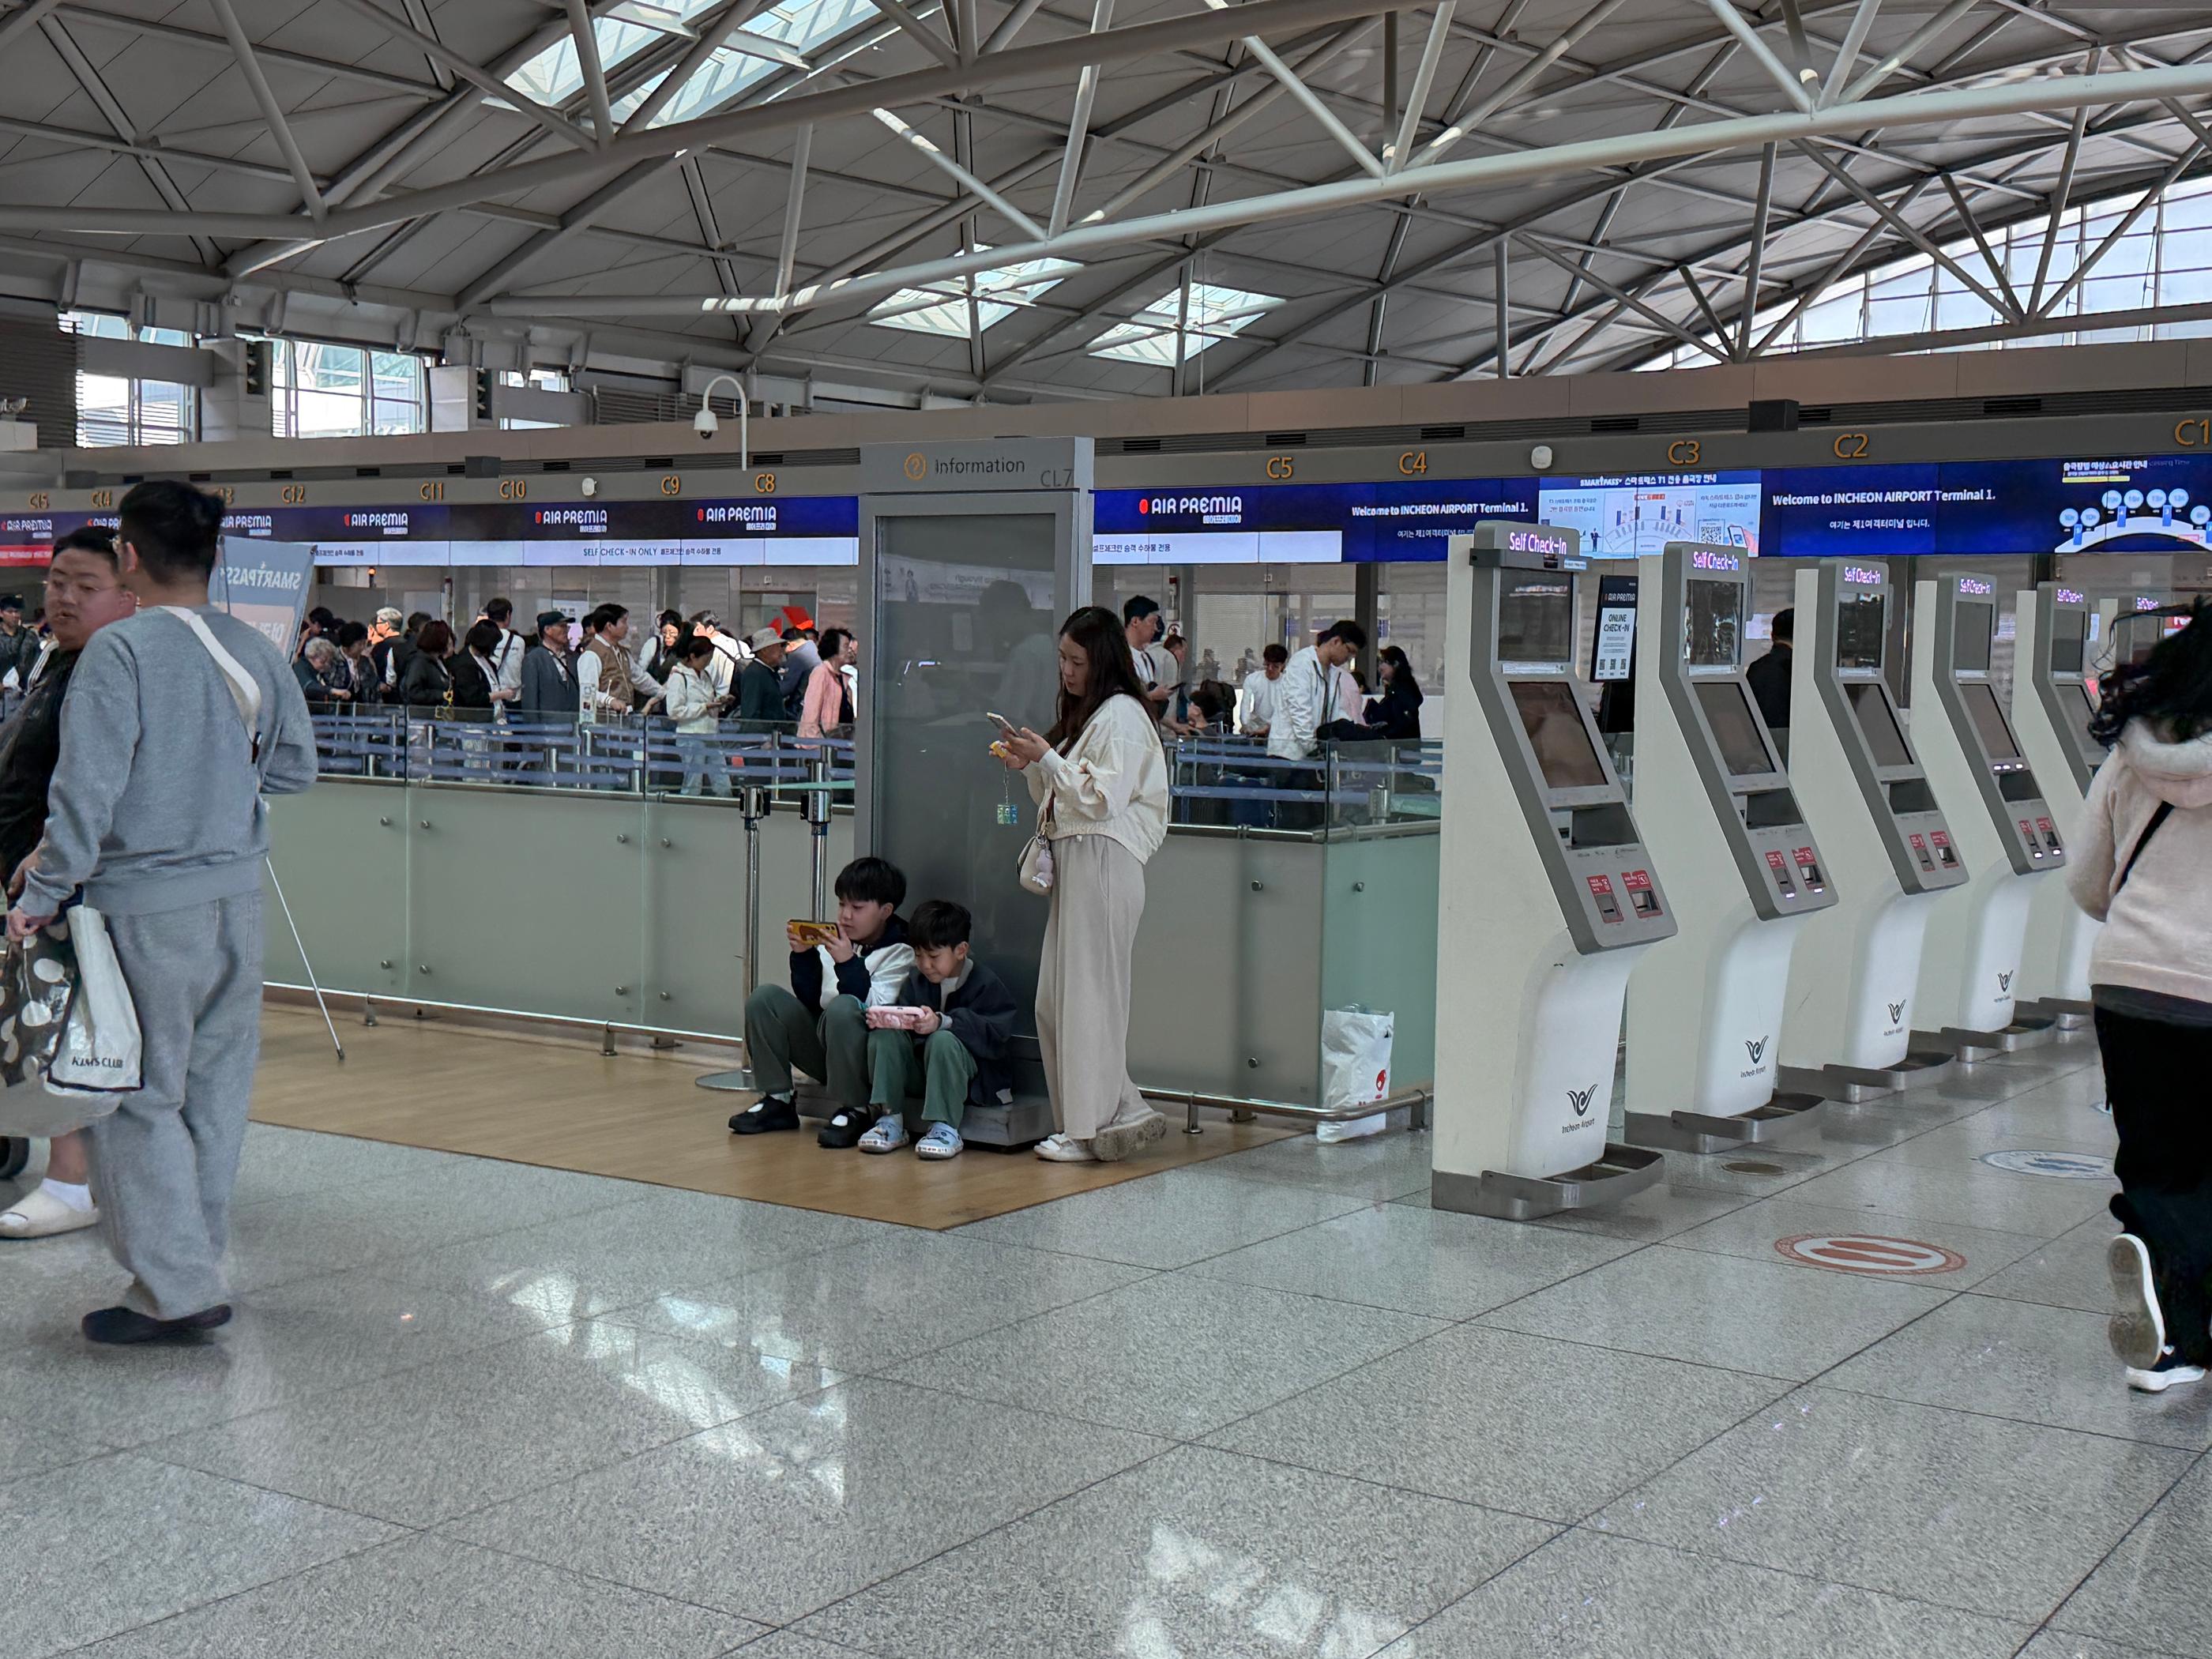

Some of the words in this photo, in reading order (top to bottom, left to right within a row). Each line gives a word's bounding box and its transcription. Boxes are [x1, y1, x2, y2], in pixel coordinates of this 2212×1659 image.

[2174, 419, 2210, 446] C1
[1668, 440, 1701, 465] C3
[1833, 433, 1869, 459] C2
[935, 457, 1025, 474] Information
[1266, 456, 1293, 479] C5
[1398, 451, 1428, 475] C4
[660, 476, 680, 495] C9
[754, 473, 776, 493] C8
[1040, 468, 1074, 487] CL7
[281, 486, 305, 503] C12
[419, 482, 444, 501] C11
[499, 480, 526, 498] C10
[1773, 493, 1819, 506] Welcome
[1821, 493, 1832, 504] to
[1834, 491, 1883, 503] INCHEON
[1884, 490, 1933, 502] AIRPORT
[1935, 488, 1984, 502] Terminal
[1986, 489, 1996, 500] 1.
[29, 493, 50, 510] C15
[91, 491, 112, 508] C14
[1152, 498, 1176, 514] AIR
[1179, 495, 1242, 514] PREMIA
[543, 510, 562, 525] AIR
[562, 509, 608, 524] PREMIA
[706, 507, 725, 522] AIR
[728, 506, 777, 521] PREMIA
[1352, 506, 1389, 516] Welcome
[1390, 506, 1399, 515] to
[1401, 504, 1440, 515] INCHEON
[1440, 503, 1478, 514] AIRPORT
[1480, 502, 1519, 514] Terminal
[1520, 502, 1529, 512] 1.
[235, 514, 272, 528] PREMIA
[351, 514, 367, 526] AIR
[369, 513, 408, 526] PREMIA
[1830, 521, 1850, 529] 여기는
[583, 547, 599, 557] SELF
[638, 547, 656, 556] ONLY
[1509, 532, 1526, 552] Self
[1528, 532, 1567, 555] Check-In
[1693, 551, 1706, 569] Self
[1708, 552, 1739, 571] Check-In
